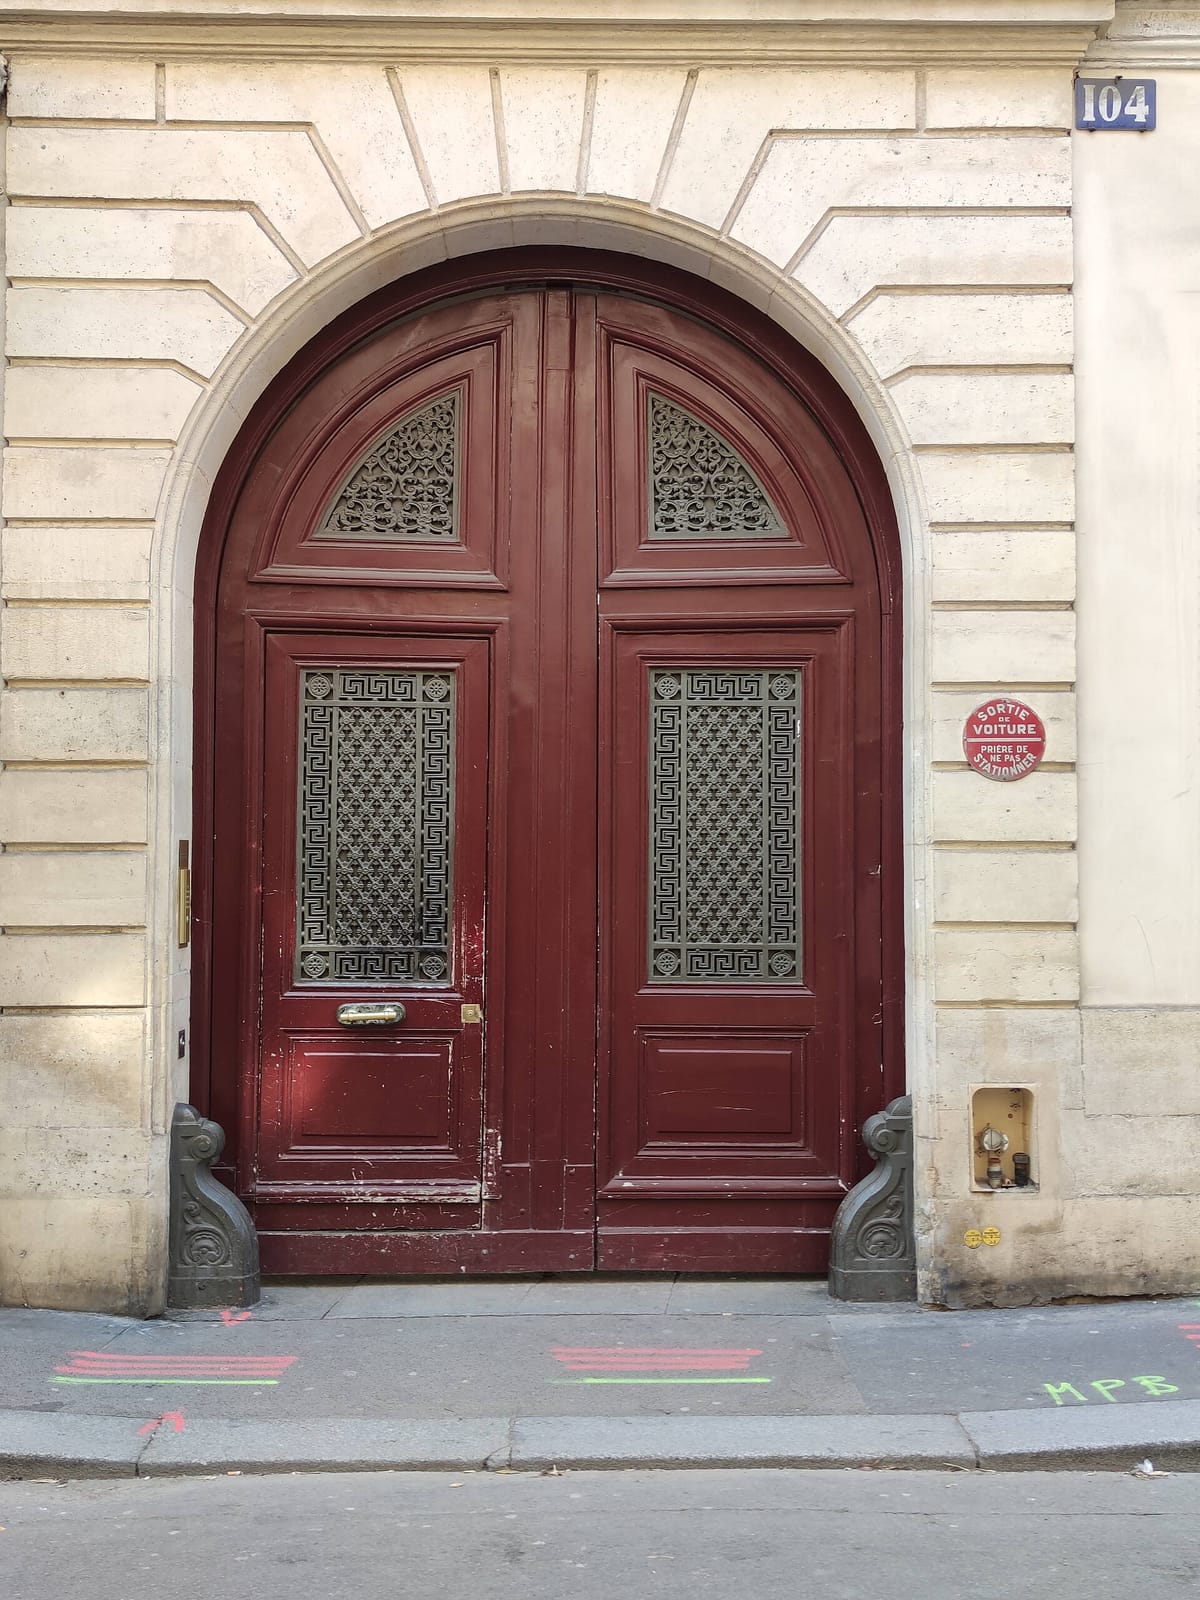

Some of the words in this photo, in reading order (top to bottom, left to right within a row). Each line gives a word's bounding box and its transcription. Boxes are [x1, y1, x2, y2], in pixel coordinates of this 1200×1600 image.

[1082, 84, 1149, 122] 104
[977, 703, 1030, 721] SORTIE
[973, 724, 1036, 735] VOITURE
[990, 754, 1001, 762] NE
[1004, 754, 1021, 762] PAS
[1017, 745, 1029, 753] DE
[973, 752, 1037, 776] STATIONNER
[1043, 1375, 1179, 1405] MPB
